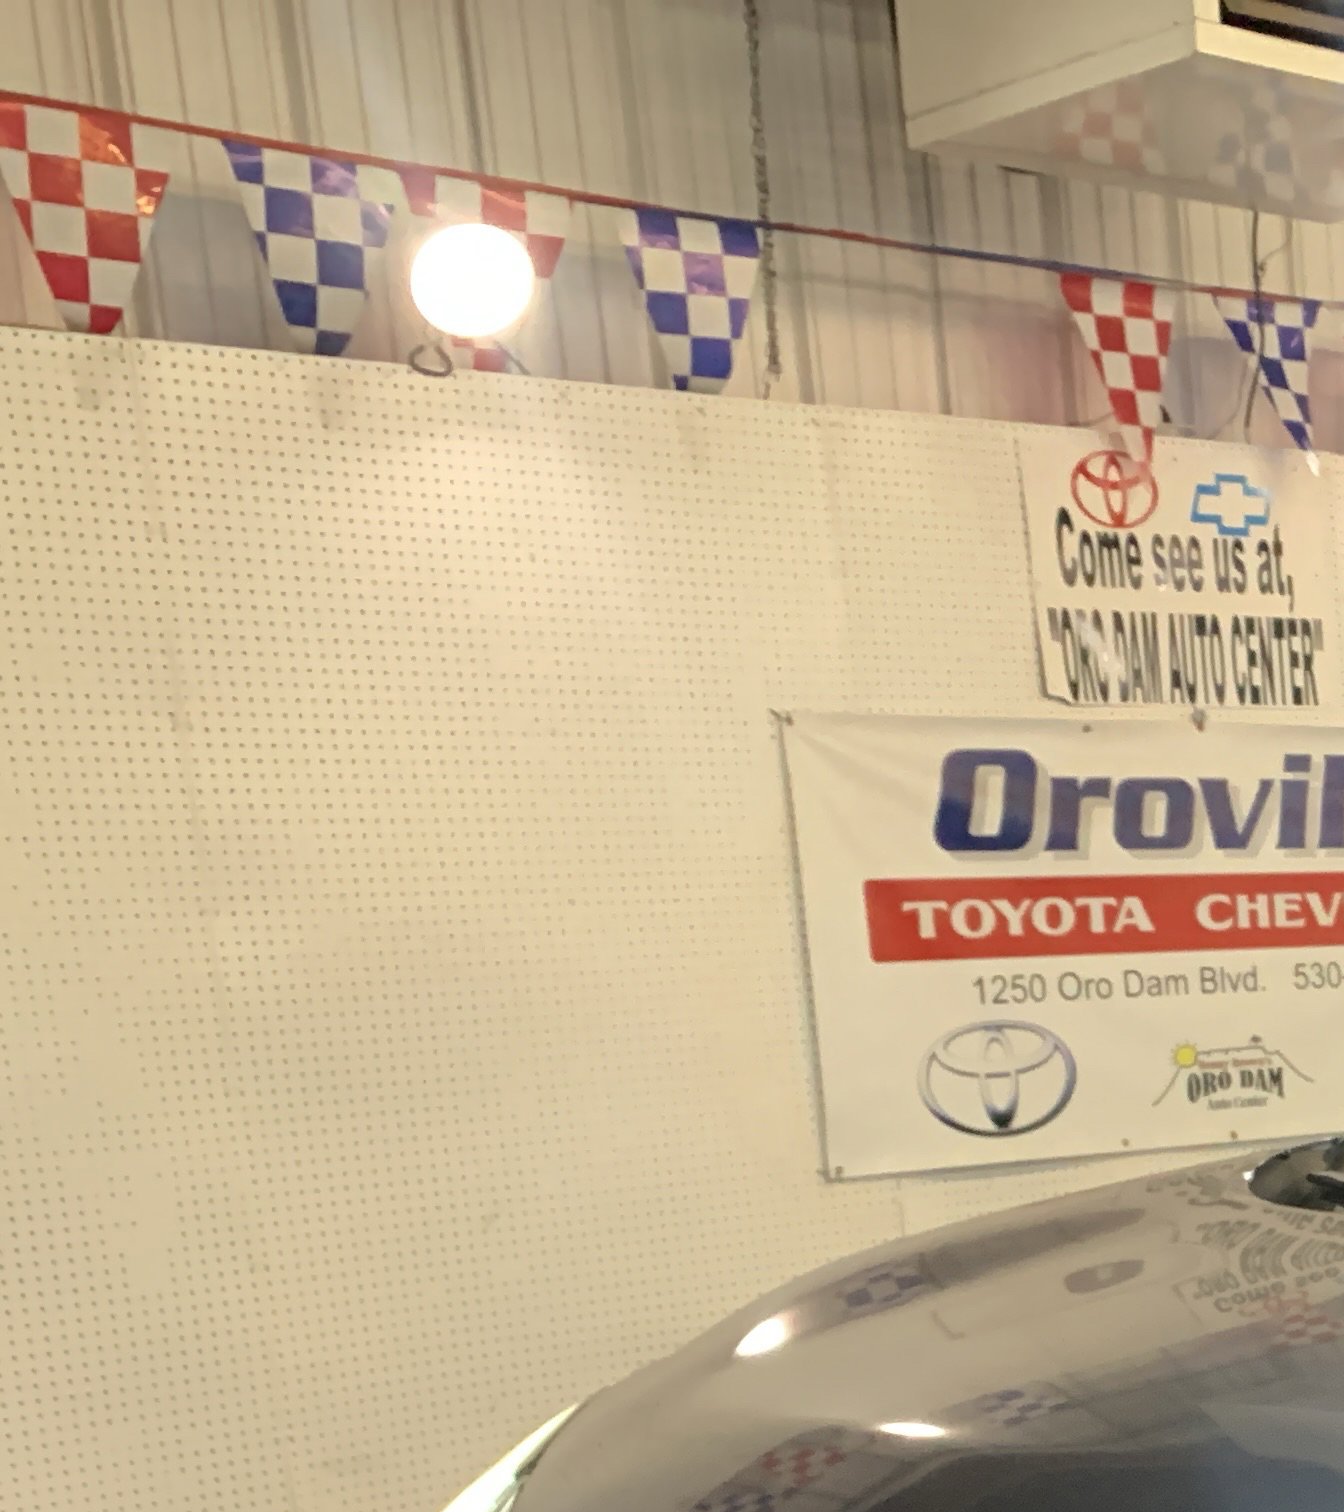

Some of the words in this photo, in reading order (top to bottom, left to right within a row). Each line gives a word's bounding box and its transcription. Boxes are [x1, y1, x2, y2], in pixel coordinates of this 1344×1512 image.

[1055, 507, 1143, 590] Come
[1151, 533, 1204, 592] see
[1212, 537, 1247, 594] us
[1256, 523, 1294, 613] at,
[1112, 610, 1164, 704] DAM
[1168, 612, 1225, 704] AUTO
[902, 896, 1156, 940] TOYOTA
[971, 973, 1048, 1006] 1250
[1057, 971, 1114, 1004] Oro
[1123, 969, 1190, 999] Dam
[1200, 964, 1266, 997] Blvd.
[1187, 1071, 1232, 1104] ORO
[1240, 1066, 1285, 1099] DAM
